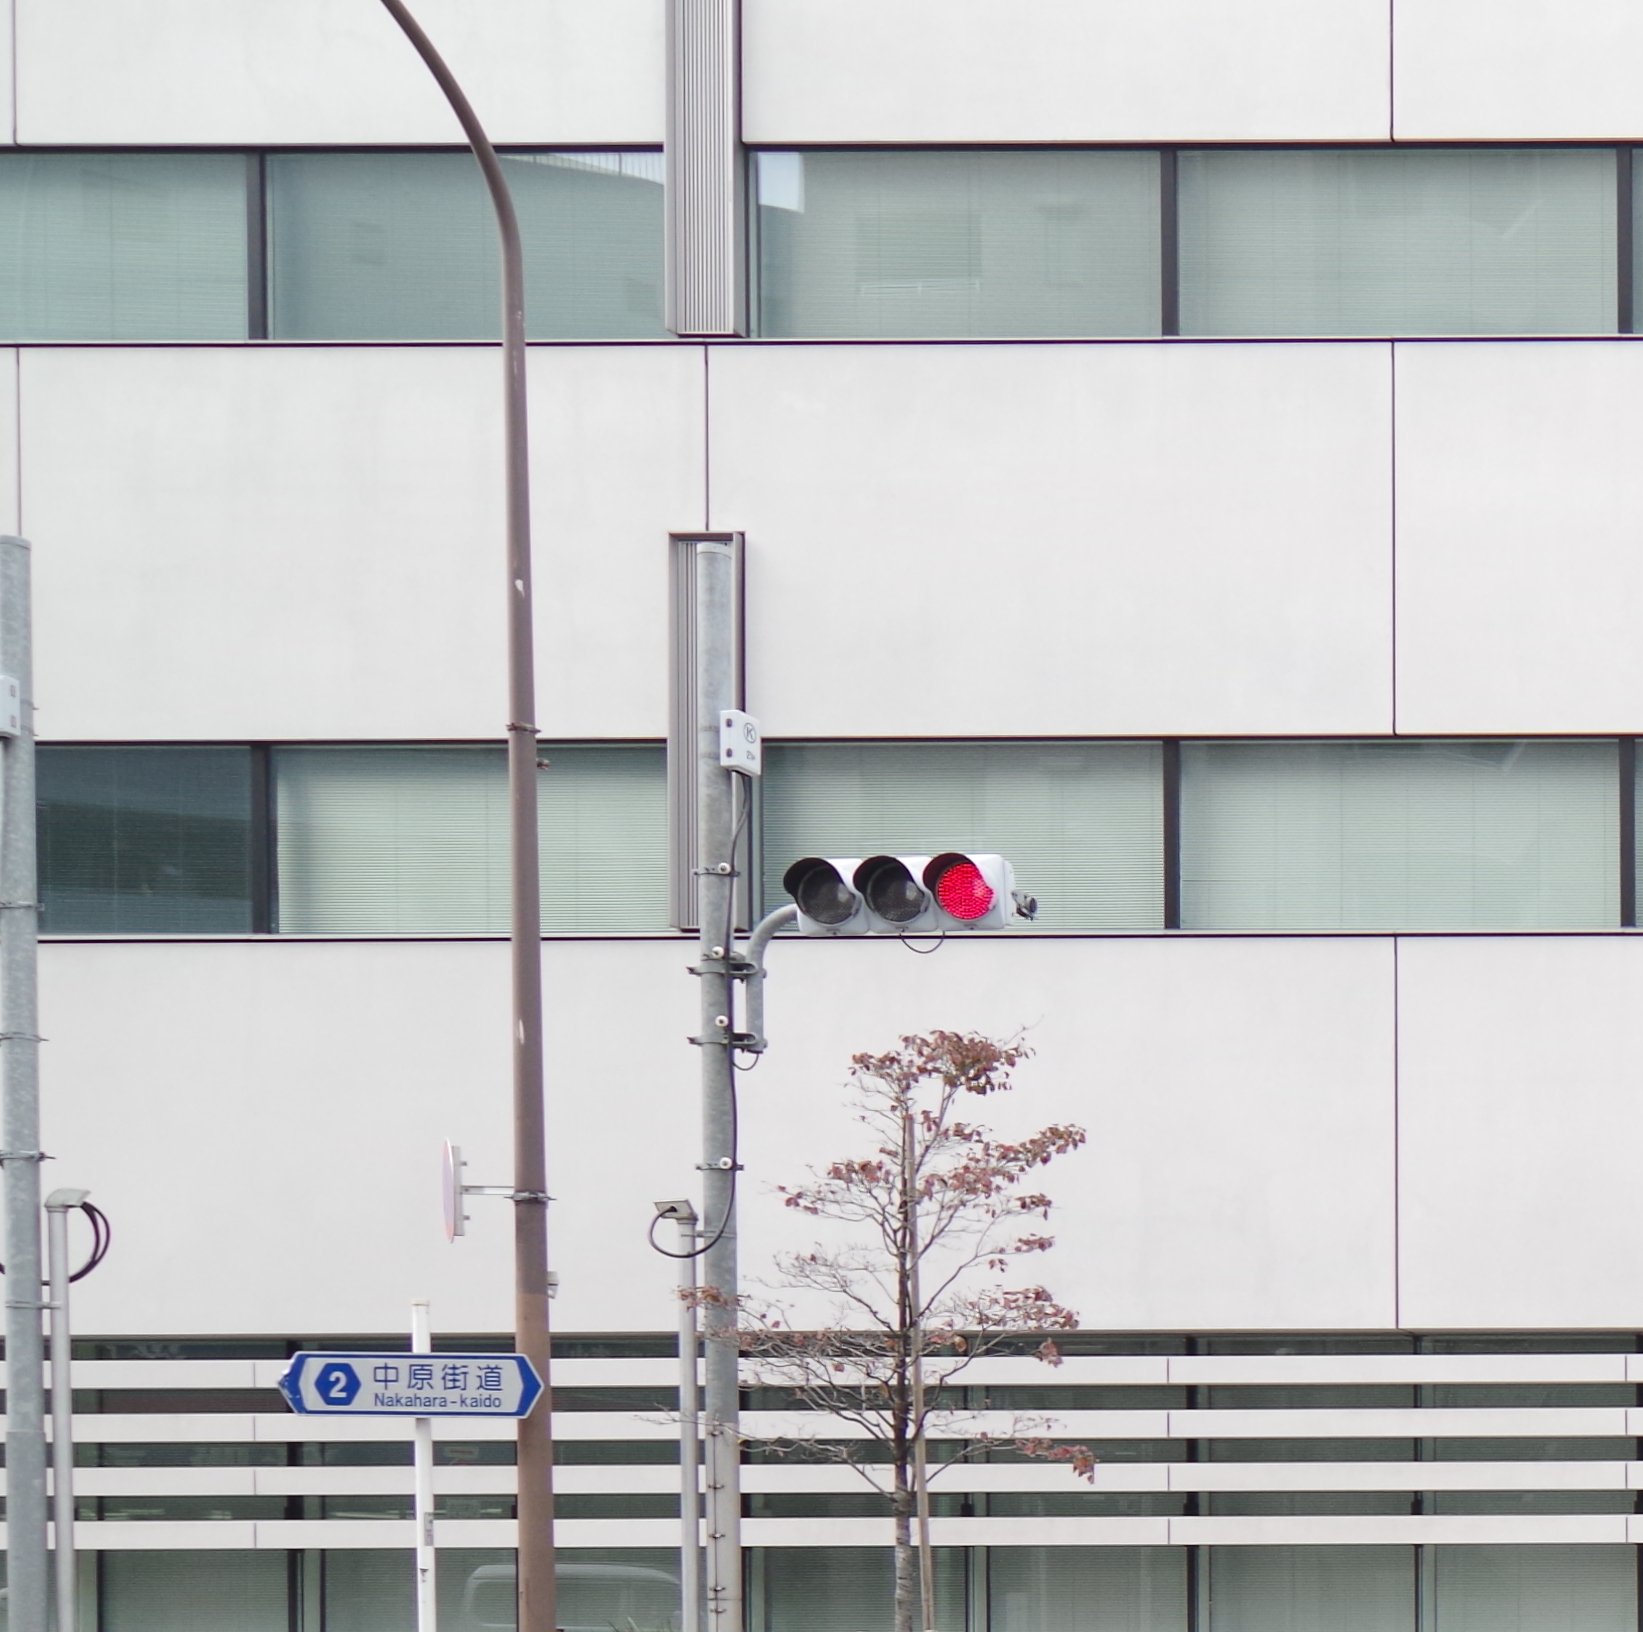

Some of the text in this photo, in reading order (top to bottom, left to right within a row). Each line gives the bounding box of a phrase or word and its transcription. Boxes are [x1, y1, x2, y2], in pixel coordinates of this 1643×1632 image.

[328, 1371, 348, 1399] 2
[373, 1362, 504, 1392] 中原街道
